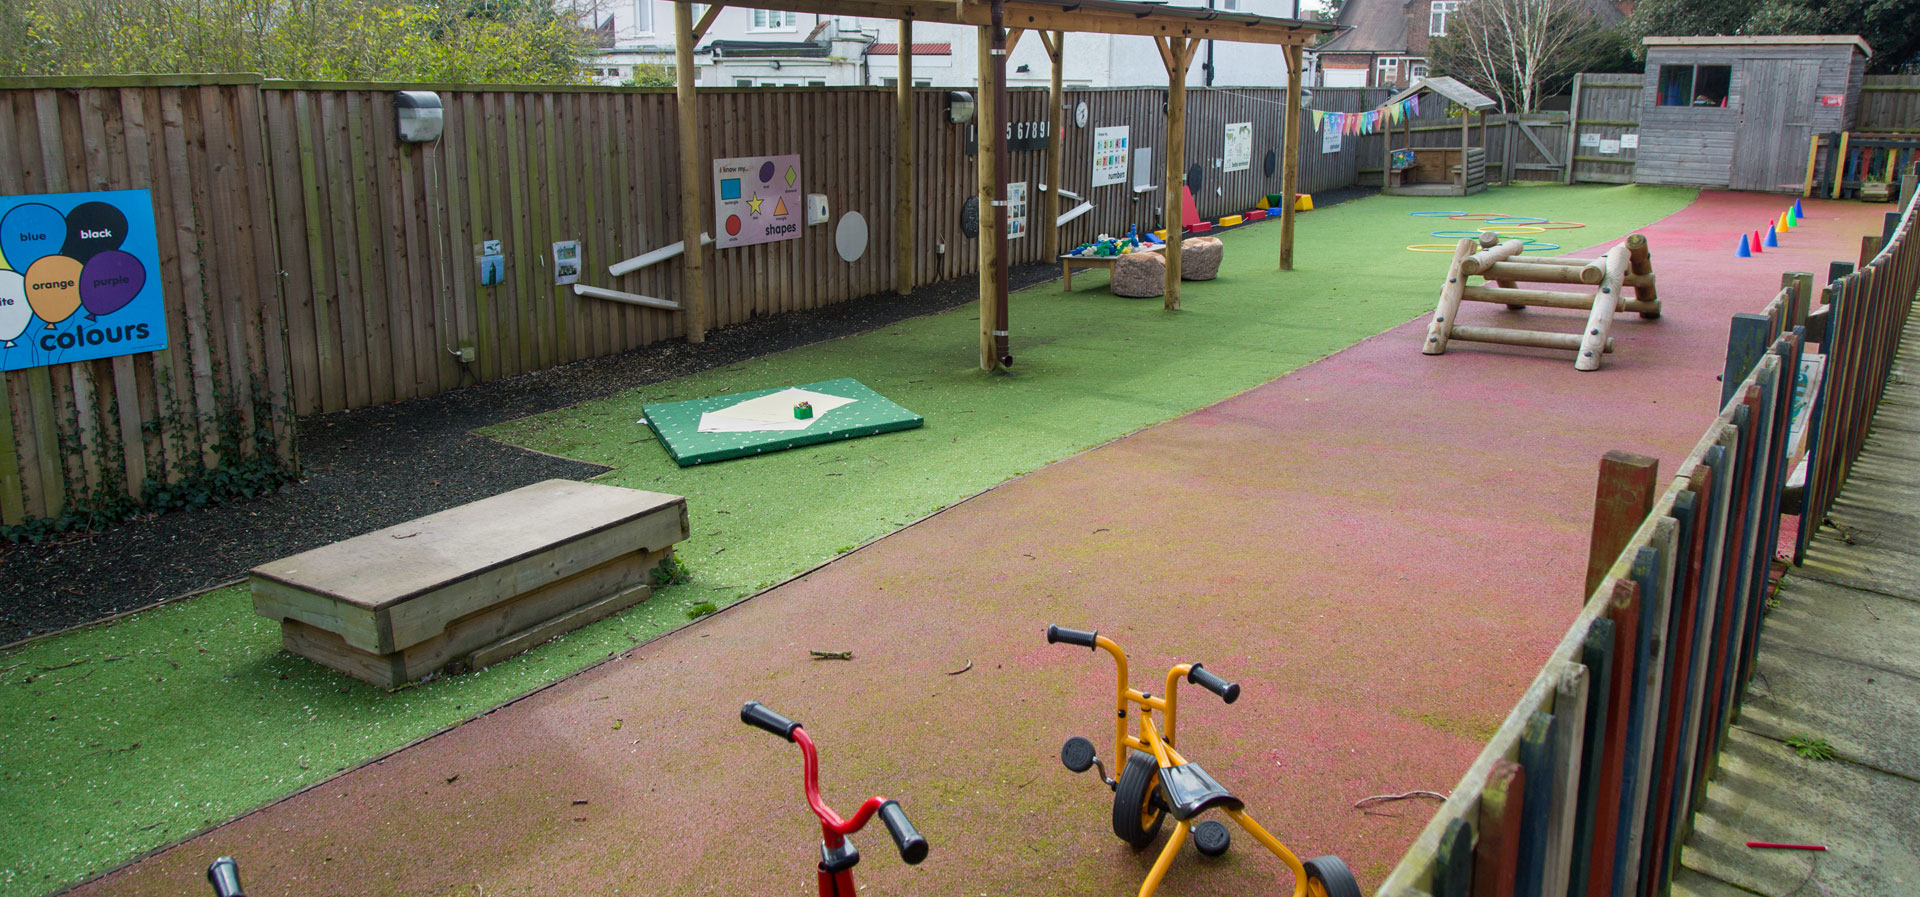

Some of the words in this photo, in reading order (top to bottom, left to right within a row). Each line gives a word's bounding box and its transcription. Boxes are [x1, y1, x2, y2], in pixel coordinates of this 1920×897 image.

[1108, 171, 1126, 180] numbers
[80, 228, 113, 240] black
[765, 223, 797, 237] shapes
[20, 231, 47, 242] blue
[32, 279, 75, 291] orange
[93, 275, 129, 288] purple
[0, 297, 15, 307] ite
[39, 322, 150, 351] colours
